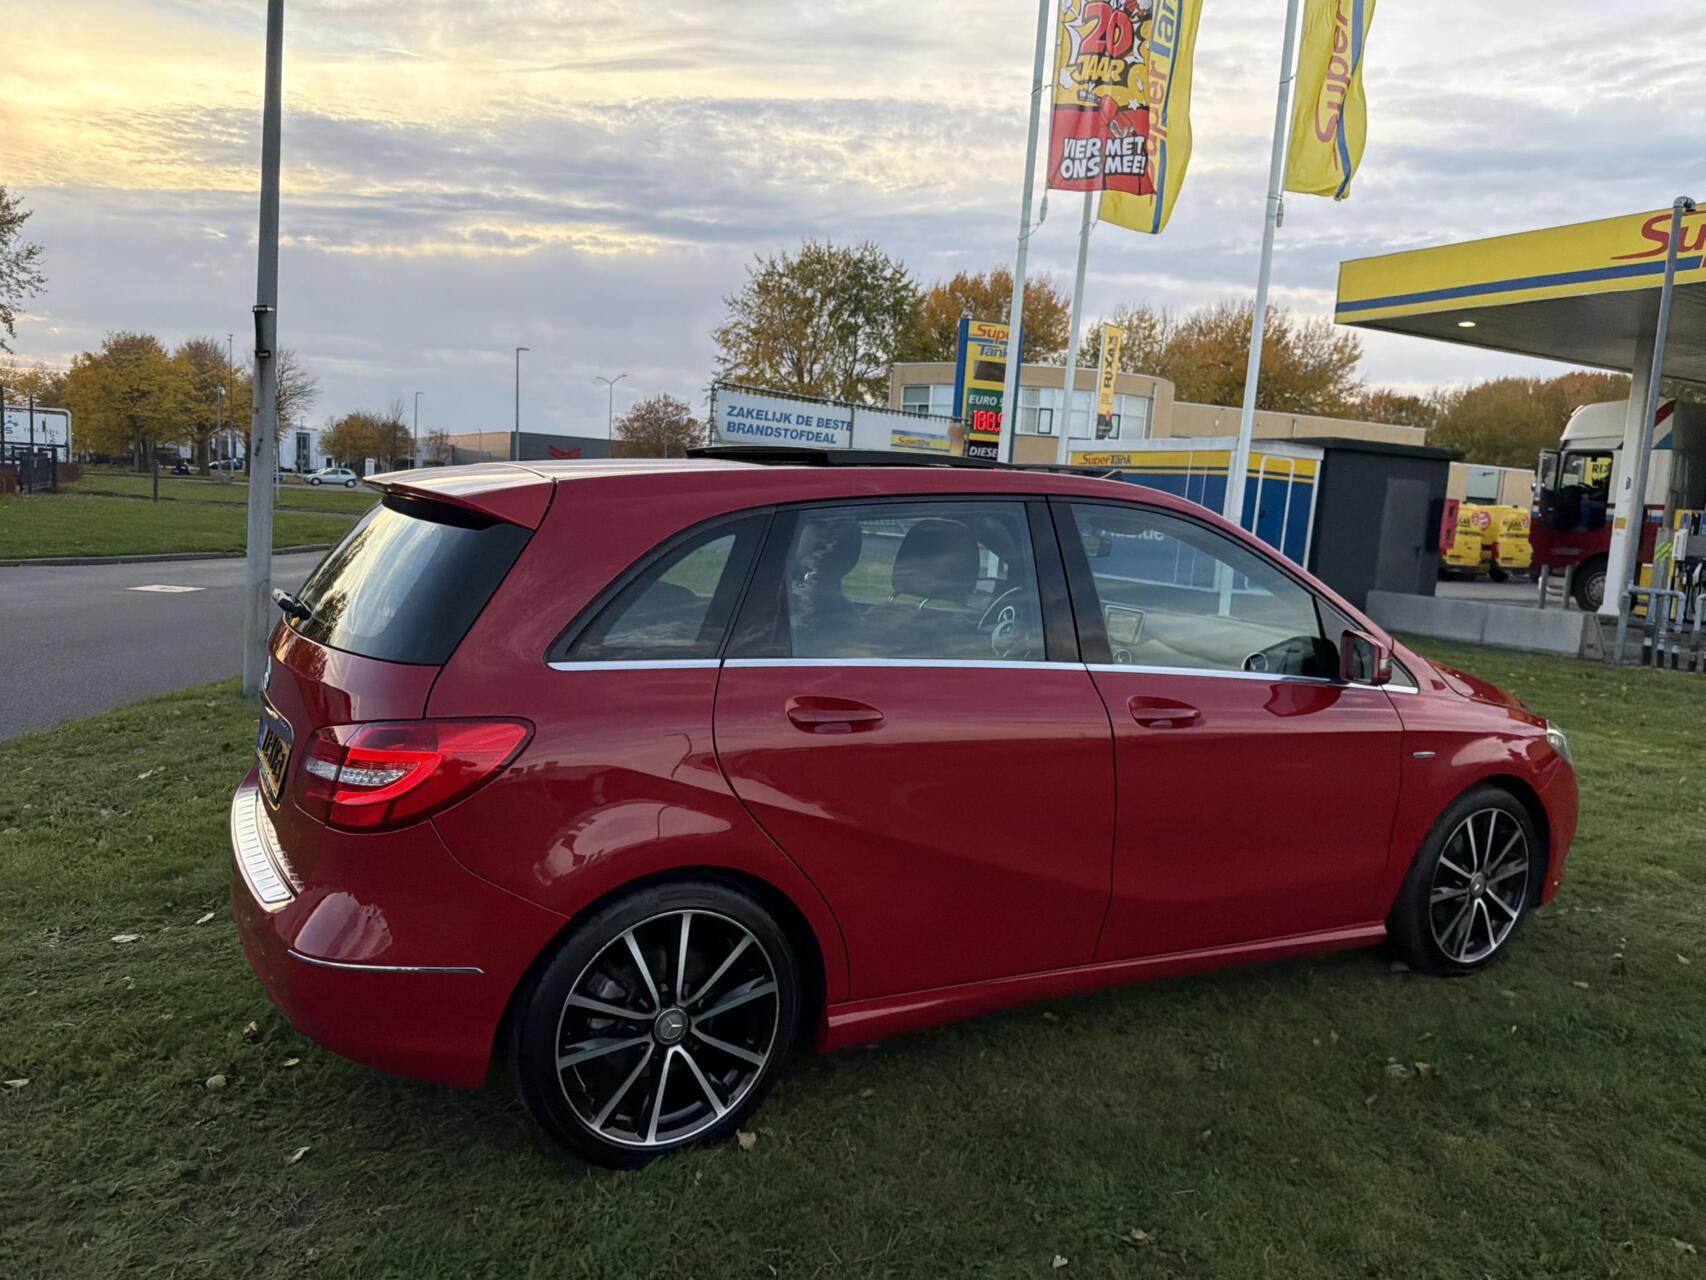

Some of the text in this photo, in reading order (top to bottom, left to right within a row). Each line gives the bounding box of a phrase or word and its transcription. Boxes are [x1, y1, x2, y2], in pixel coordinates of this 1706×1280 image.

[1081, 2, 1133, 57] 20
[1072, 55, 1125, 82] JAAR
[1063, 137, 1145, 158] VIER MET
[1061, 156, 1145, 179] ONS MEE!
[968, 394, 997, 406] EURO
[727, 405, 853, 432] ZAKELIJK DE BESTE
[726, 421, 837, 444] BRANDSTOFDEAL
[968, 446, 998, 458] DIESE
